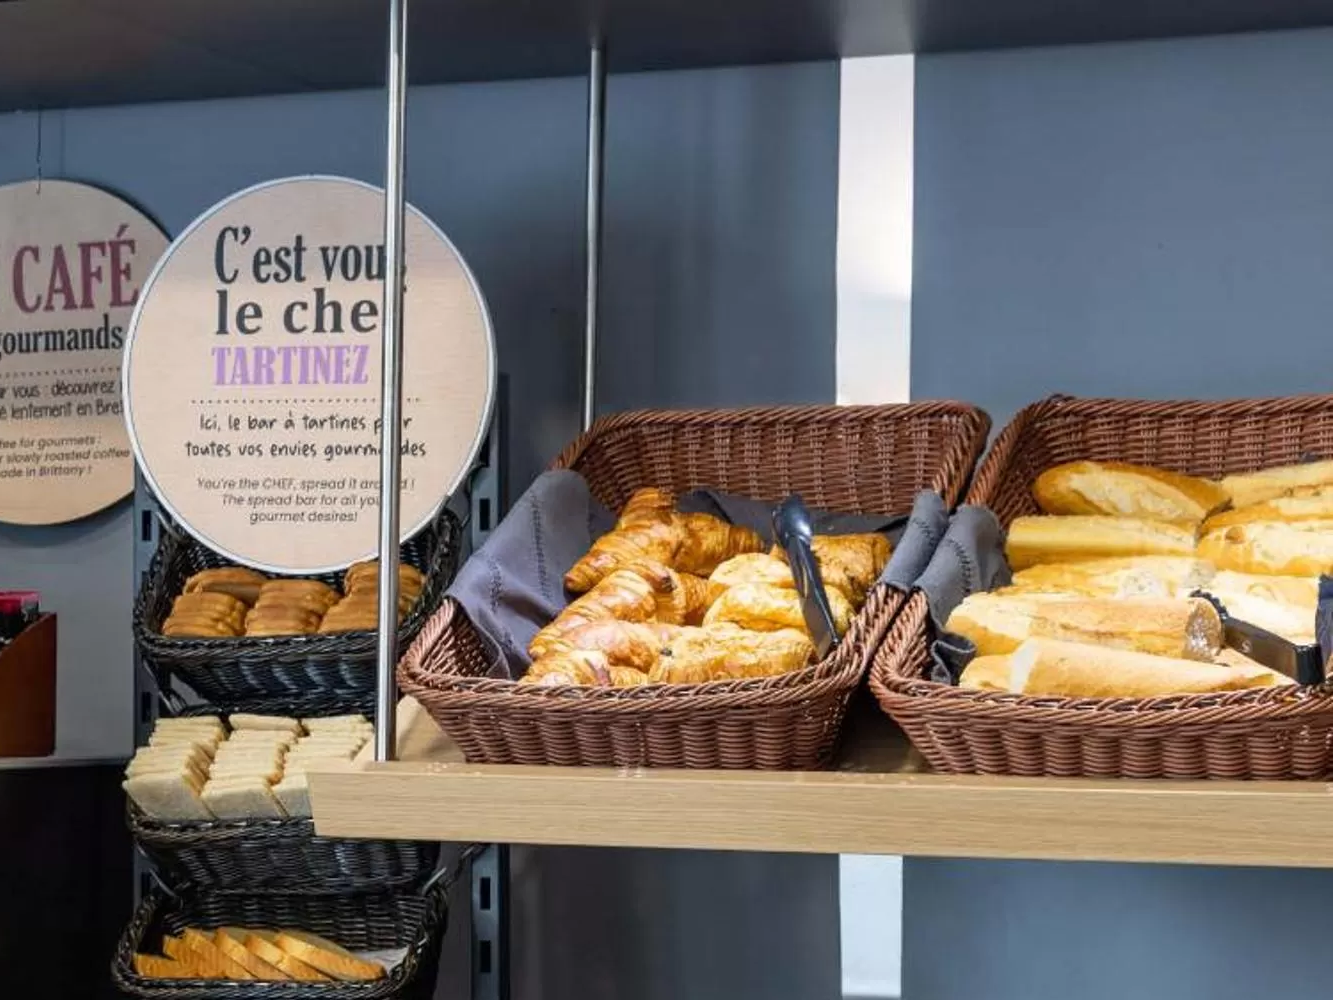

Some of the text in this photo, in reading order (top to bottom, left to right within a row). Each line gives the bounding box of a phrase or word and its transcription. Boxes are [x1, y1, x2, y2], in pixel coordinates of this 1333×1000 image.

[215, 225, 407, 284] C'est vou
[12, 223, 139, 313] CAFÉ
[216, 287, 407, 335] le che
[211, 345, 370, 385] TARTINEZ
[12, 384, 40, 399] vous
[51, 379, 115, 397] découvrez
[11, 400, 71, 419] lentement
[76, 402, 93, 417] en
[200, 410, 413, 435] Ici, le bar à tartines pr
[19, 437, 36, 448] for
[37, 435, 95, 450] gourmets
[184, 439, 426, 461] toutes vos envies gourmdes
[6, 451, 43, 466] slowly
[44, 449, 90, 462] roasted
[93, 447, 130, 460] coffee
[26, 467, 36, 477] in
[38, 466, 86, 479] Brittany
[239, 477, 260, 489] the
[301, 478, 345, 492] spread
[348, 478, 358, 489] it
[222, 494, 244, 506] The
[247, 494, 292, 508] spread
[296, 494, 317, 506] bar
[321, 494, 338, 506] for
[341, 494, 358, 506] all
[250, 511, 305, 525] gourmet
